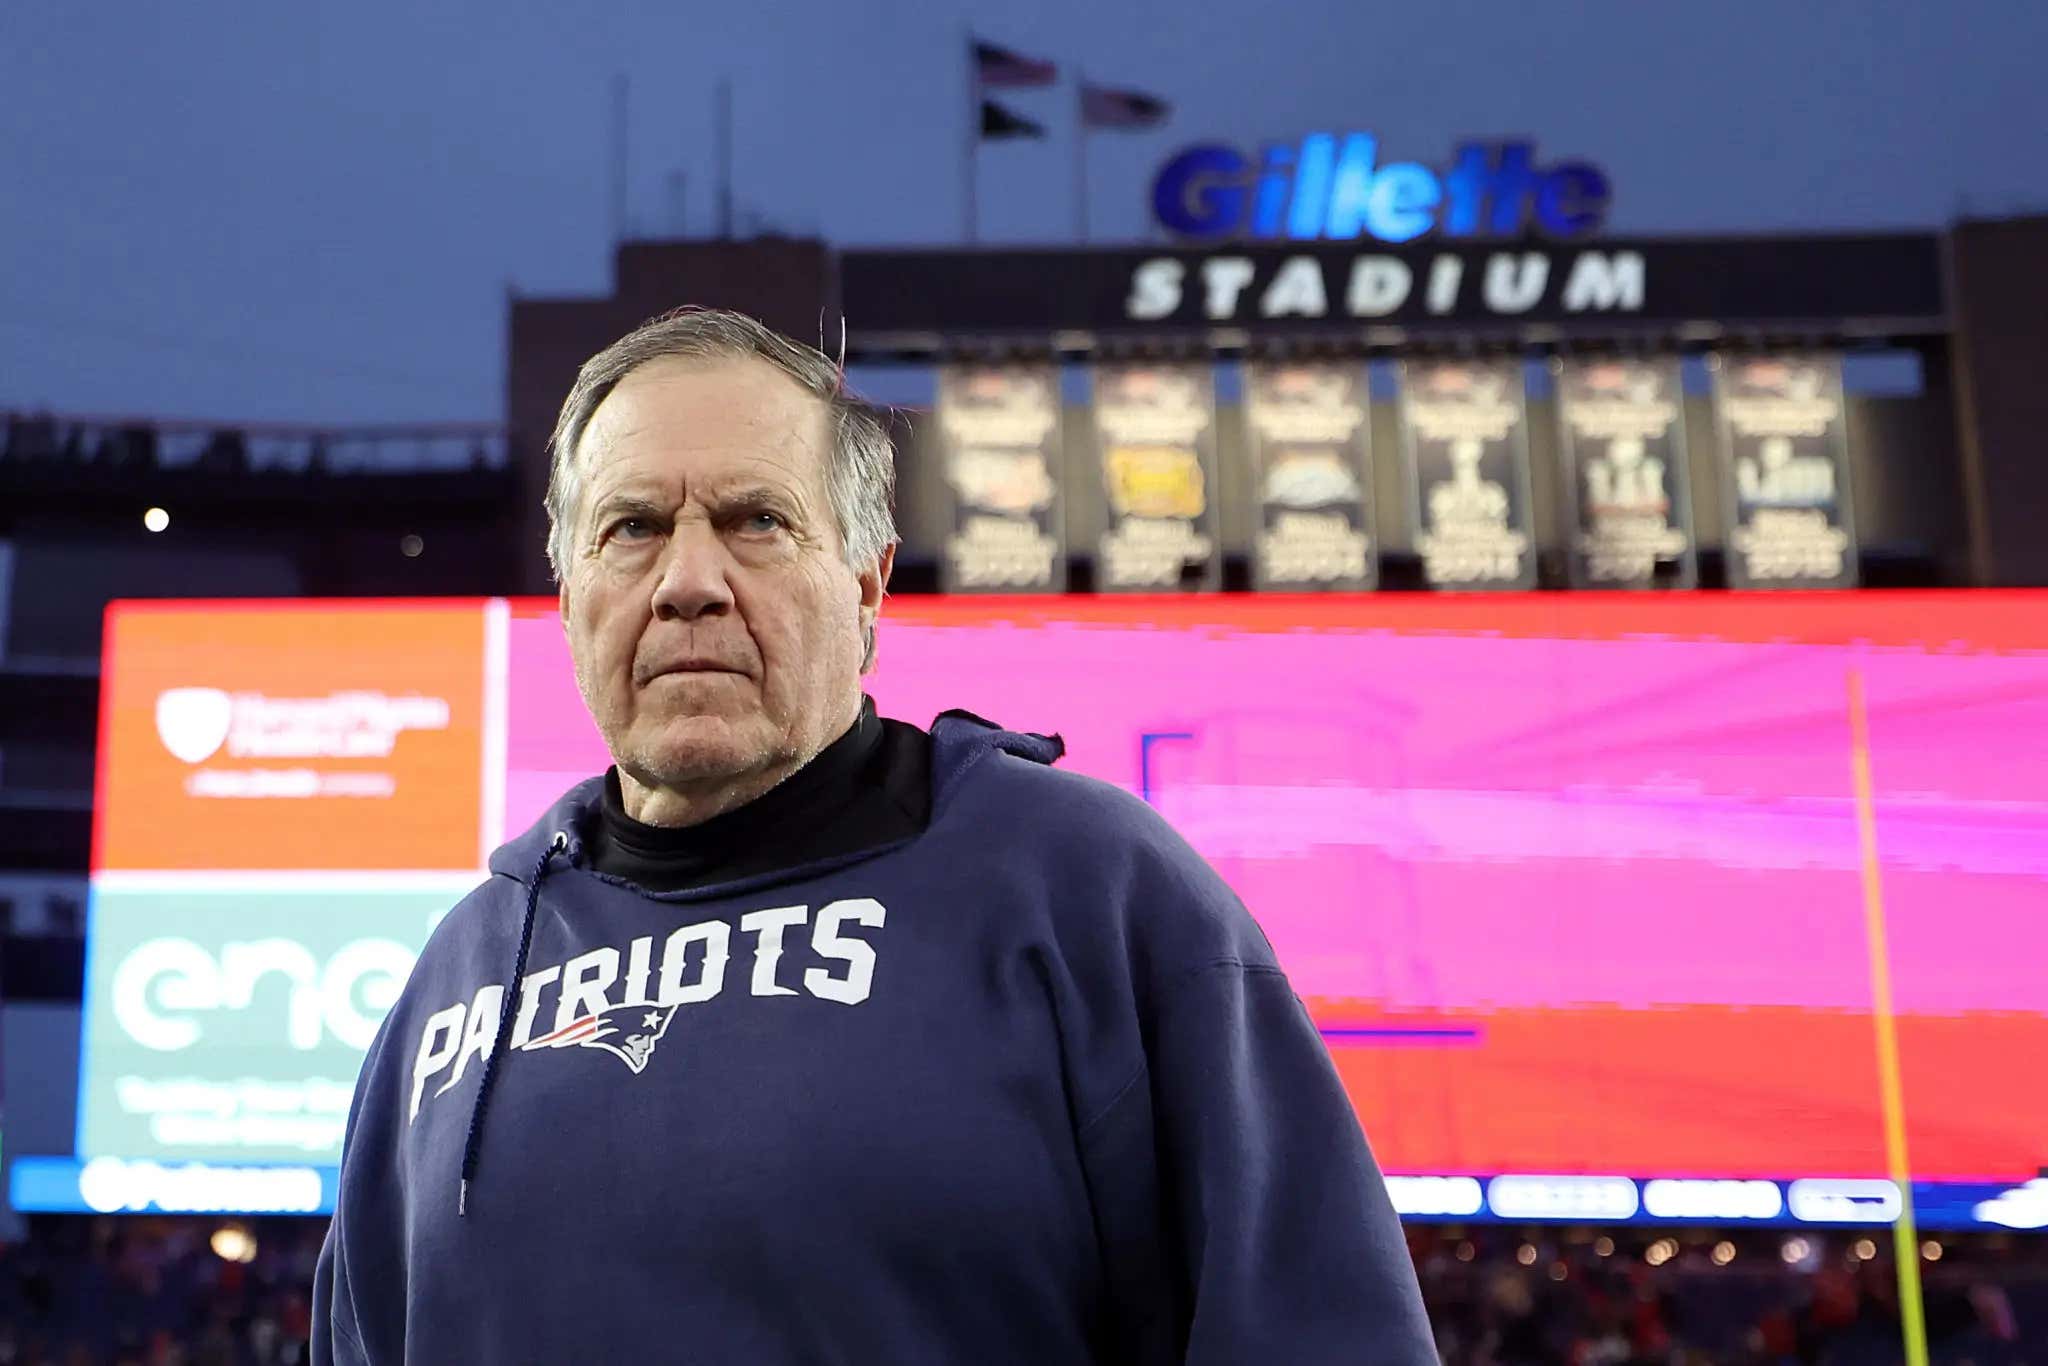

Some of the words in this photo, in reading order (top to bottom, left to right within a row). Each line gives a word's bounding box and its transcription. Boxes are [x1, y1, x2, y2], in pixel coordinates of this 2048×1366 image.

[1152, 132, 1612, 243] Gillette
[1127, 250, 1646, 319] STADIUM
[112, 910, 448, 1051] ene
[409, 898, 888, 1125] PATRIOTS
